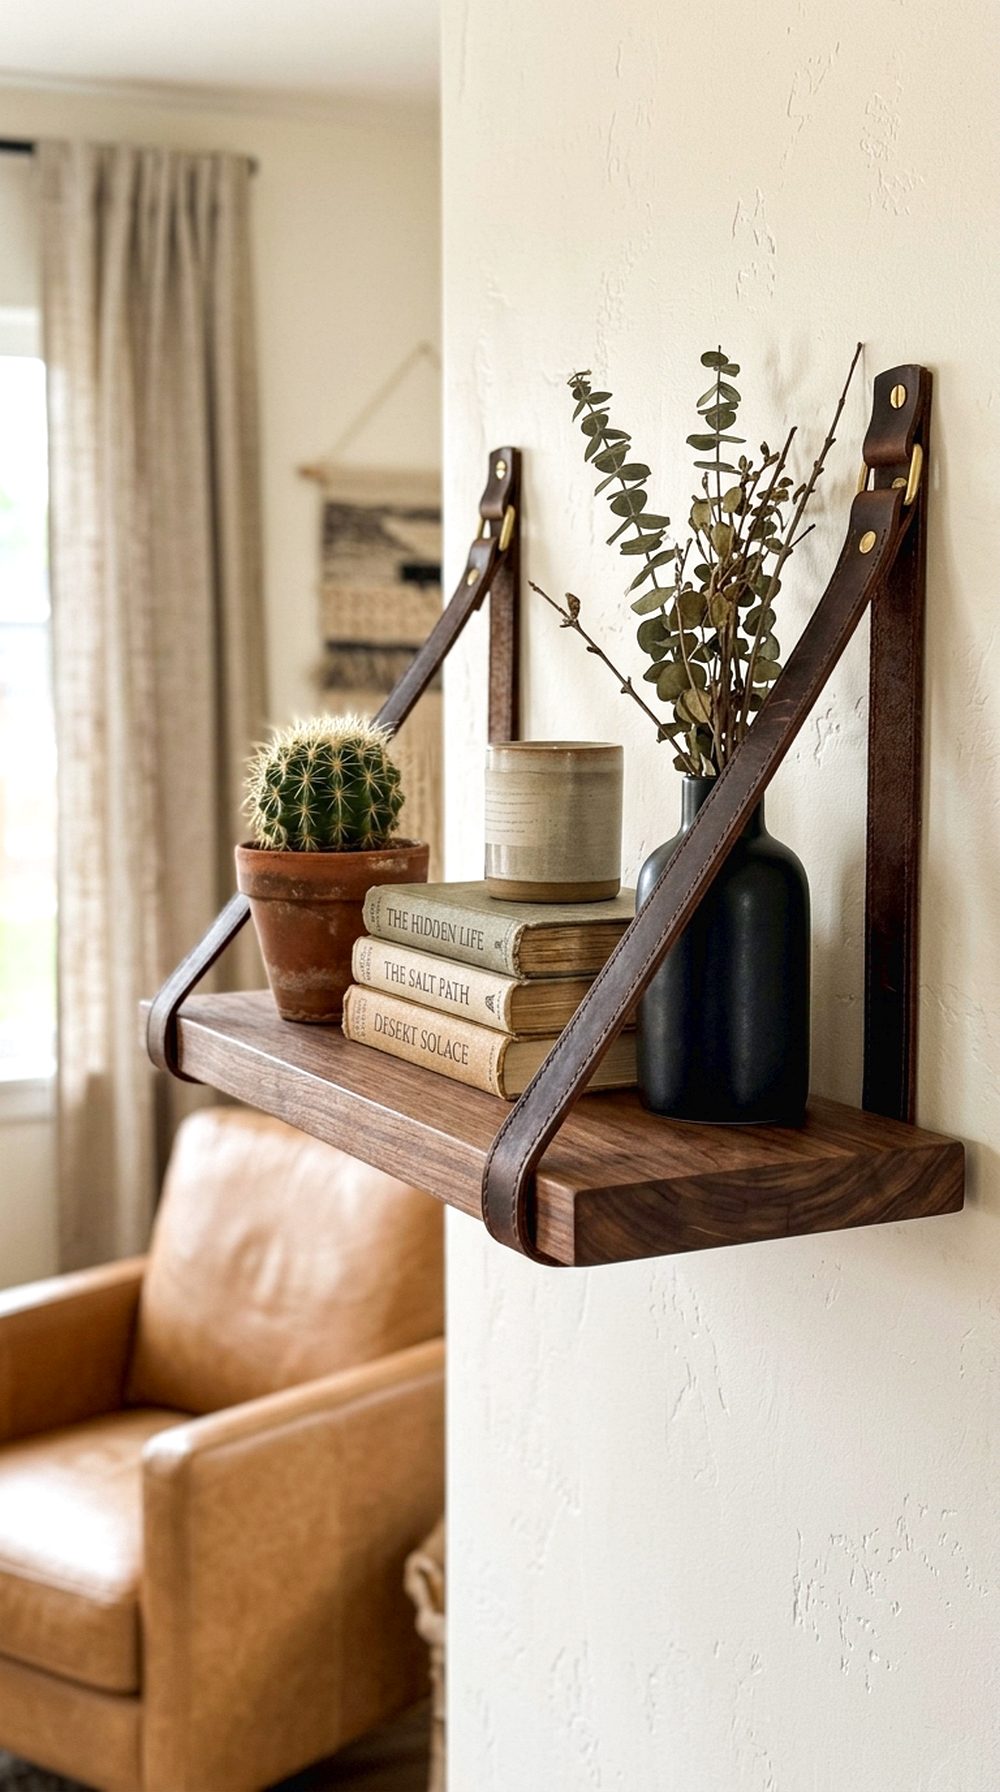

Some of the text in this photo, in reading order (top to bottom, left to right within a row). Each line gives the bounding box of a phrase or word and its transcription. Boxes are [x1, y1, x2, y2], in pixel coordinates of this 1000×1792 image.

[386, 907, 409, 929] THE
[411, 914, 457, 943] HIDDEN
[459, 926, 484, 950] LIFE
[384, 961, 406, 979] THE
[408, 969, 437, 993] SALT
[439, 979, 470, 1006] PATH
[420, 1030, 469, 1065] SOLACE
